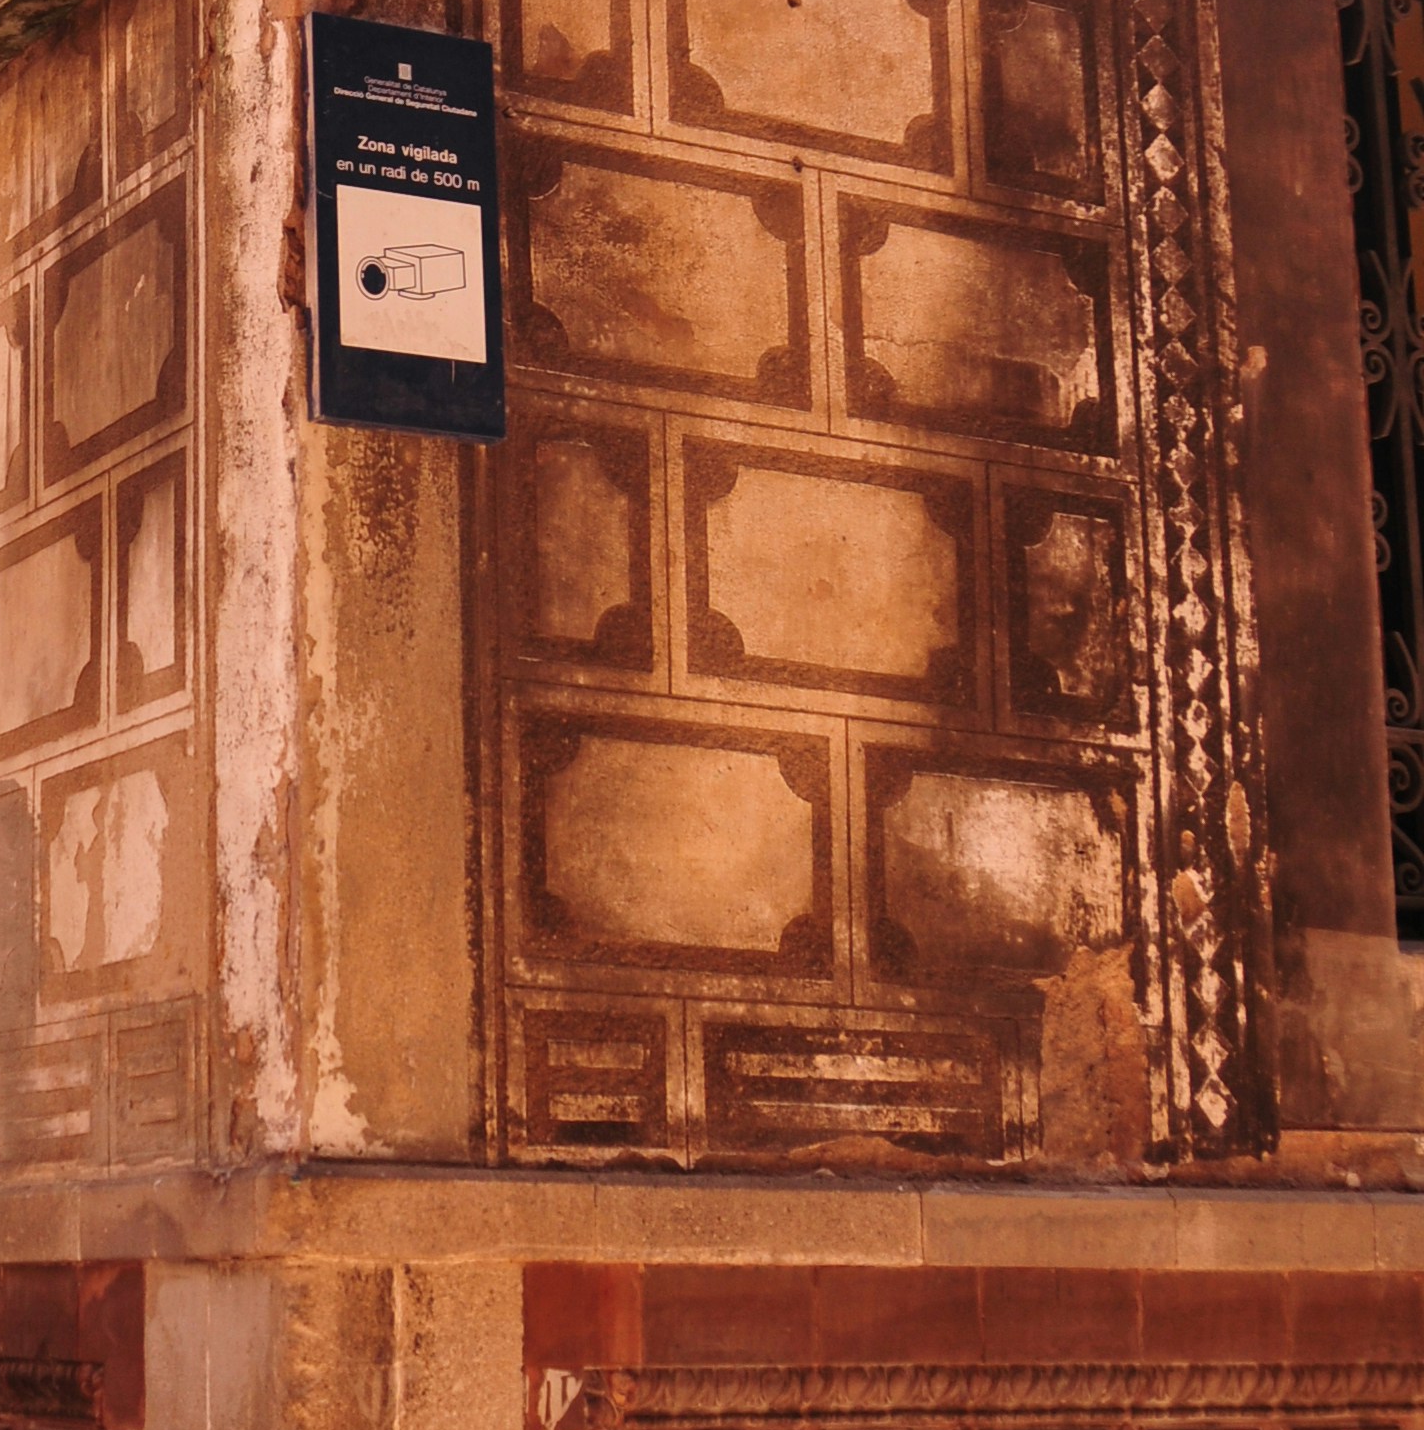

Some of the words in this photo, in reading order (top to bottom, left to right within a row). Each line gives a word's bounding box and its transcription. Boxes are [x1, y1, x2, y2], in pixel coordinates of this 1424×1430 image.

[364, 76, 401, 89] Generalitat
[413, 84, 447, 96] Catalunya
[368, 85, 412, 98] Departament
[366, 92, 393, 103] General
[357, 135, 395, 154] Zona
[401, 143, 458, 164] vigilada
[336, 159, 354, 171] en
[359, 163, 376, 175] un
[381, 166, 406, 179] radi
[411, 169, 428, 183] de
[434, 172, 462, 188] 500
[467, 179, 480, 191] m
